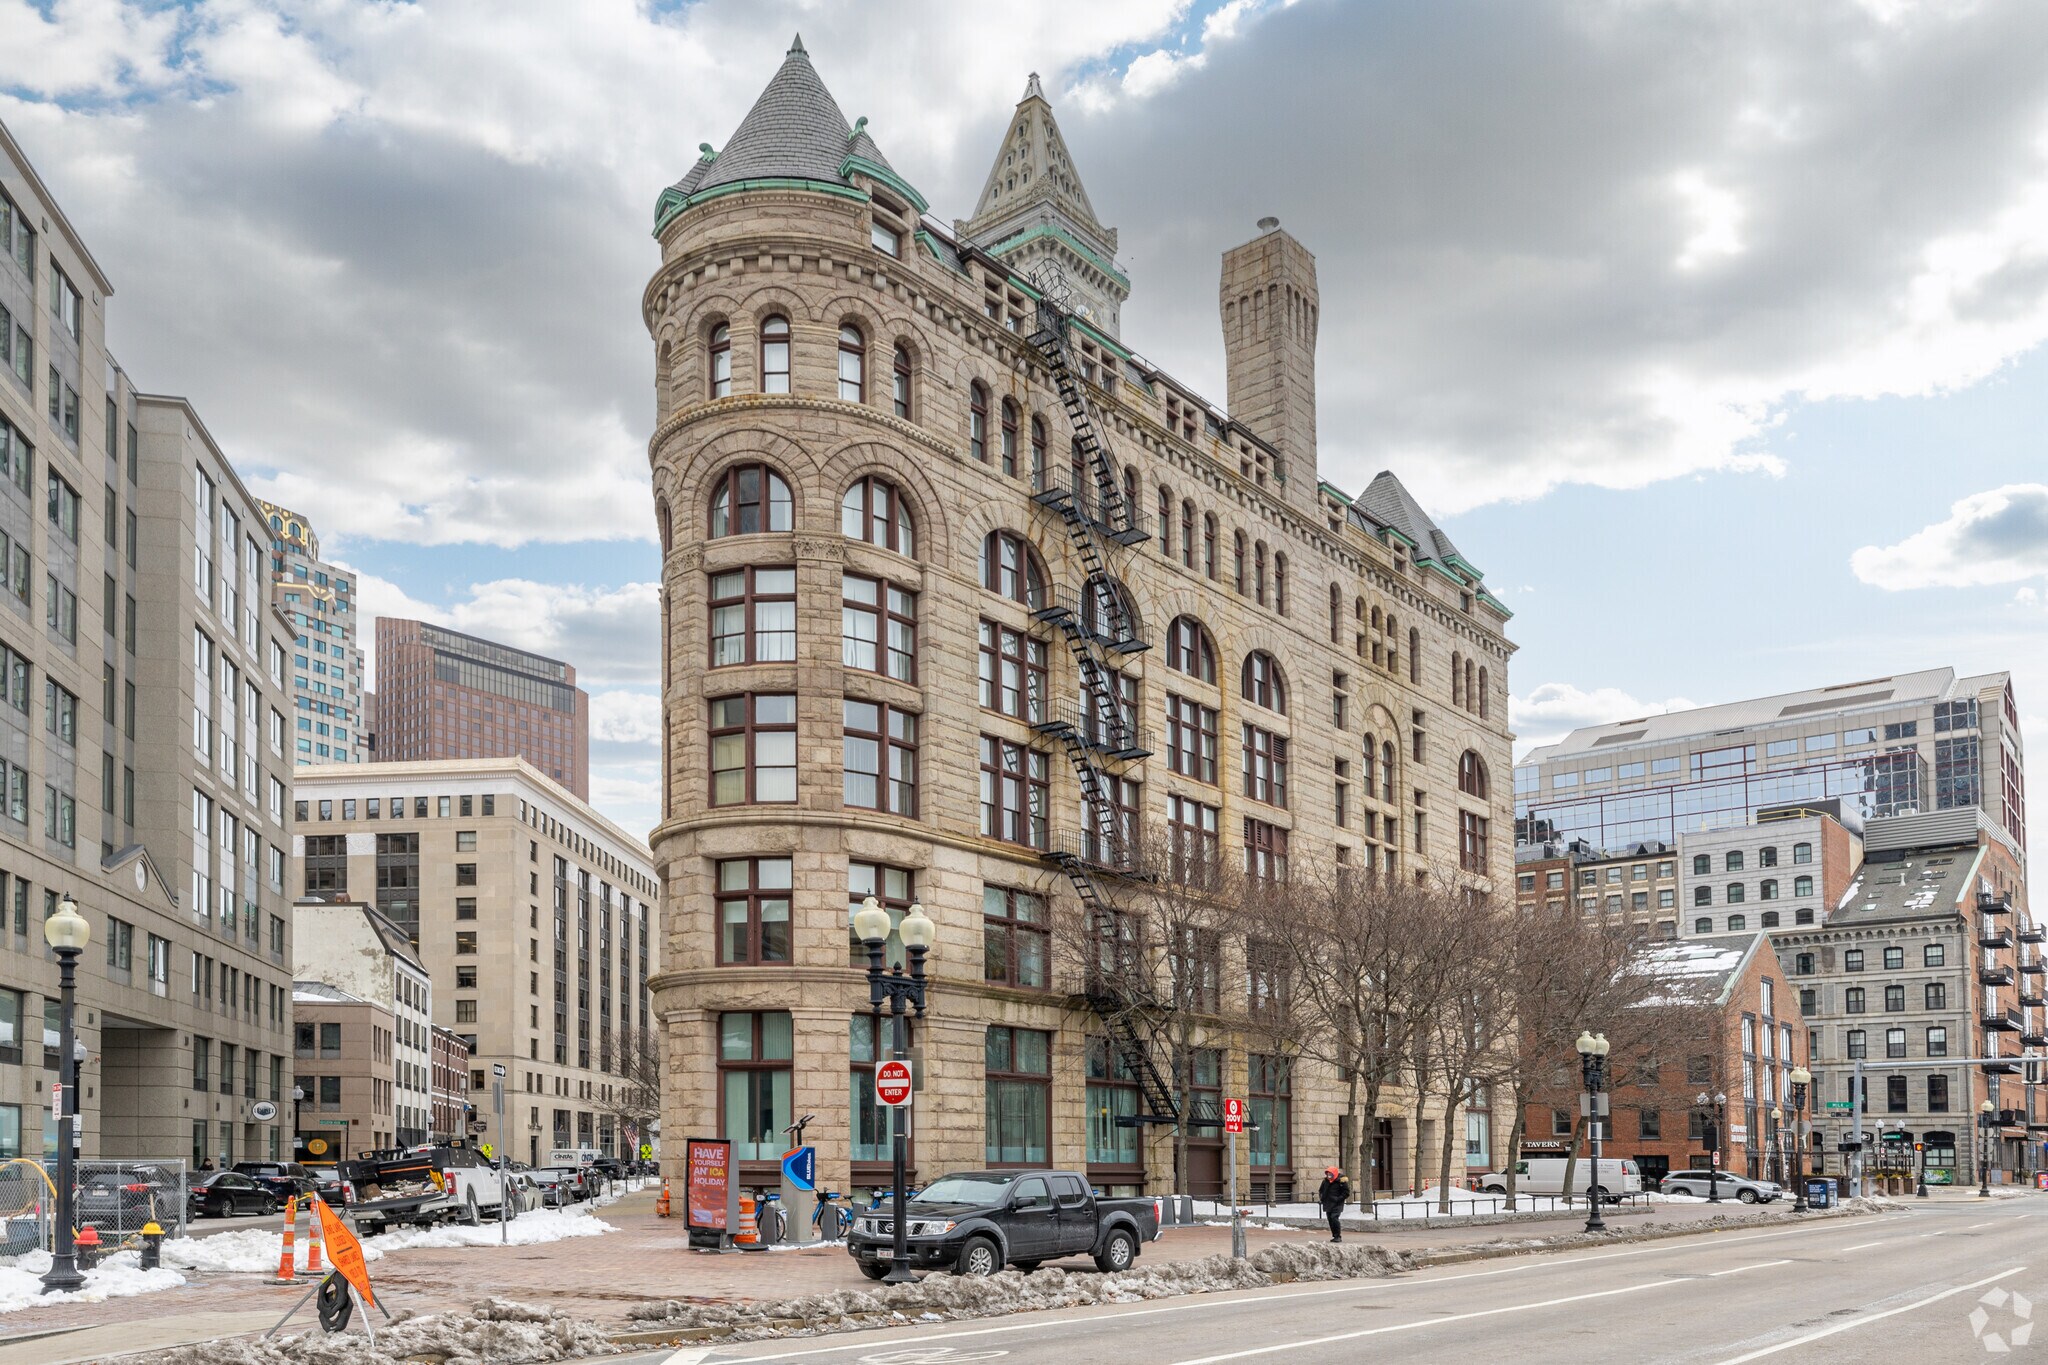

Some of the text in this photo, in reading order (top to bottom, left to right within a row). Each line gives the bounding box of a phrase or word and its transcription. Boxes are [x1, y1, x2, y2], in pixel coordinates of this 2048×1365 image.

[883, 1070, 891, 1078] DO
[884, 1088, 902, 1096] ENTER
[694, 1148, 724, 1160] HAVE
[710, 1168, 724, 1176] ICA
[694, 1177, 725, 1186] HOLIDAY
